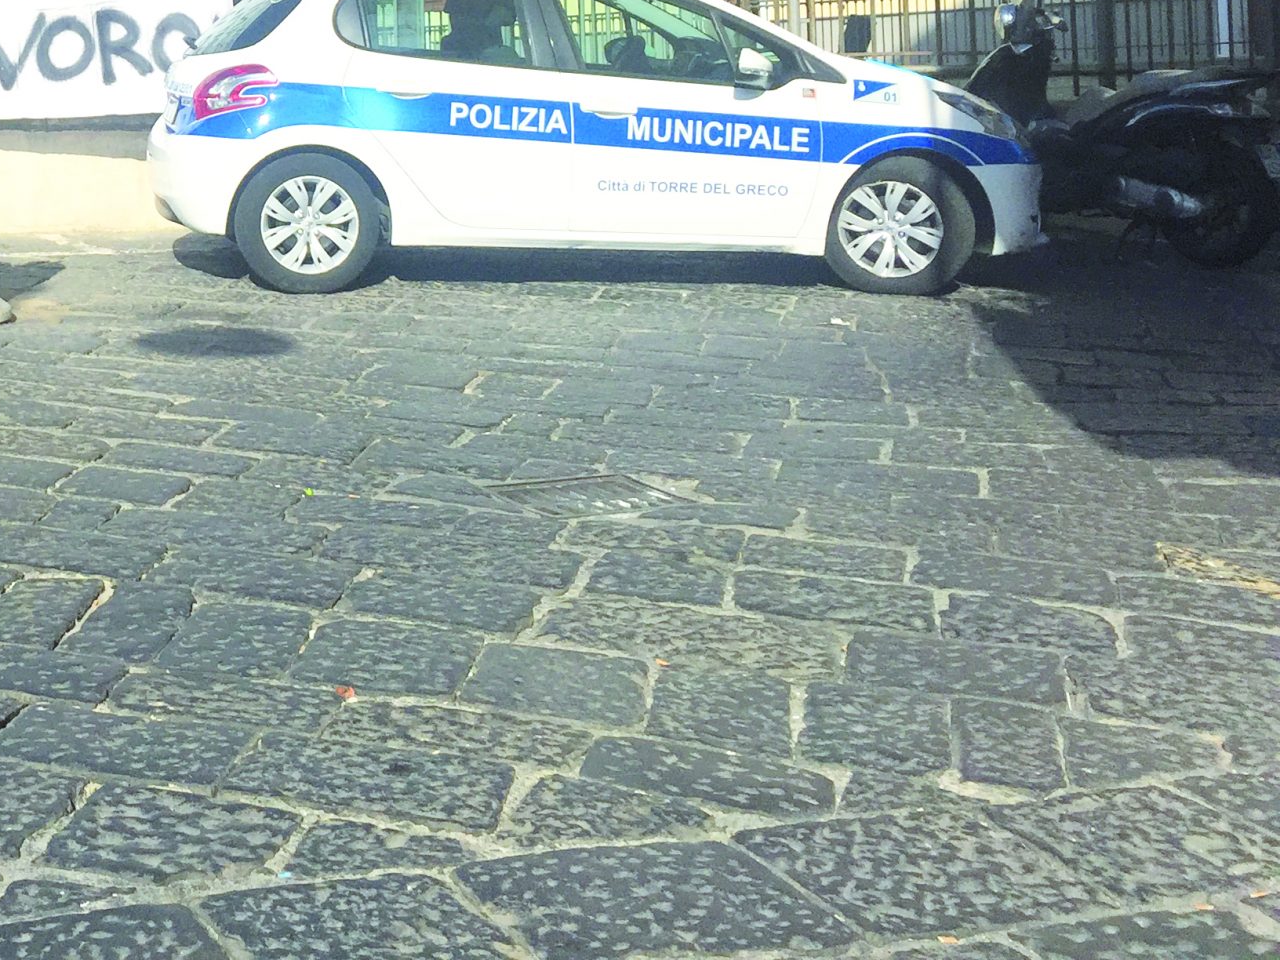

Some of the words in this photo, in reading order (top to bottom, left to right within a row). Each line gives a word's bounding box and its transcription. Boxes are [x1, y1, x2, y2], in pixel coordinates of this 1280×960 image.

[883, 91, 898, 103] 01
[449, 101, 569, 135] POLIZIA
[626, 114, 810, 153] MUNICIPALE
[597, 179, 630, 192] Città
[633, 180, 646, 193] di
[649, 181, 699, 194] TORRE
[703, 182, 731, 195] DEL
[735, 183, 790, 197] GRECO
